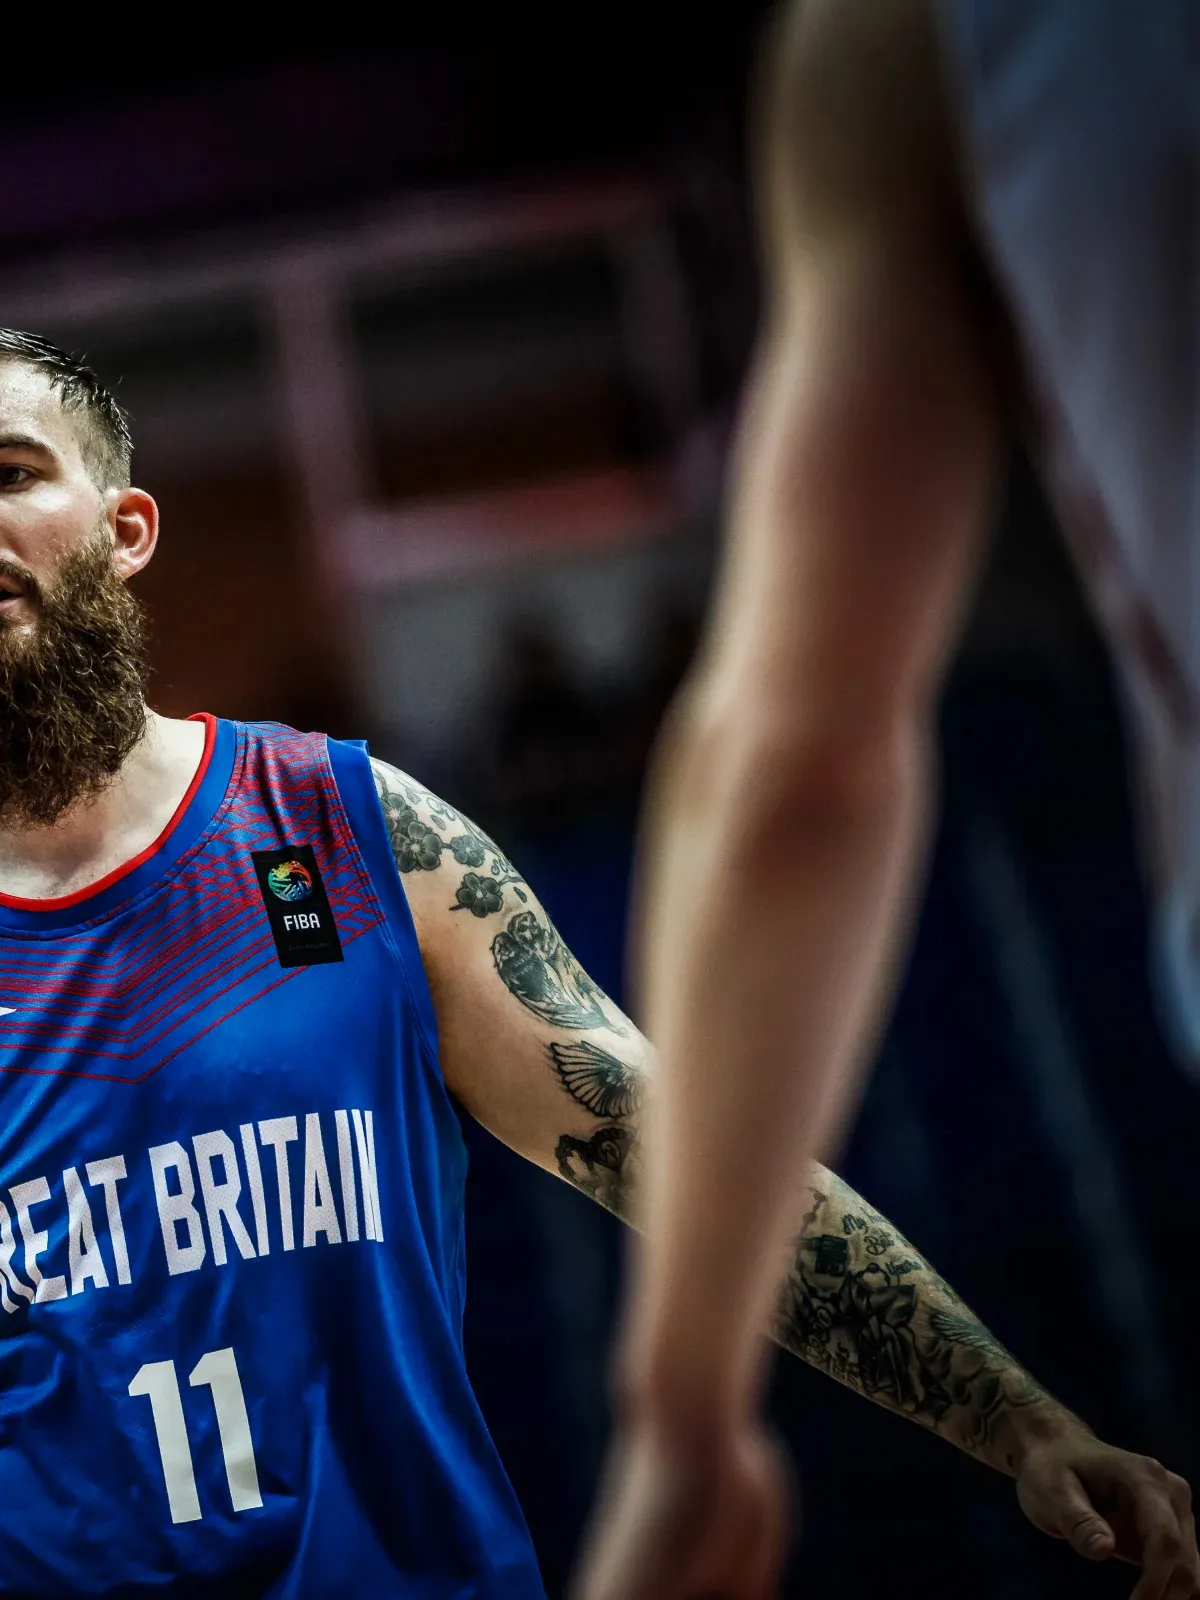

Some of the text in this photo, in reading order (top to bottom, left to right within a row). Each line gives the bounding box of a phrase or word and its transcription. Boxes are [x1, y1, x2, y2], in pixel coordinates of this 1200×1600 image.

[283, 912, 321, 931] FIBA
[148, 1109, 384, 1277] BRITAIN
[128, 1347, 263, 1524] 11
